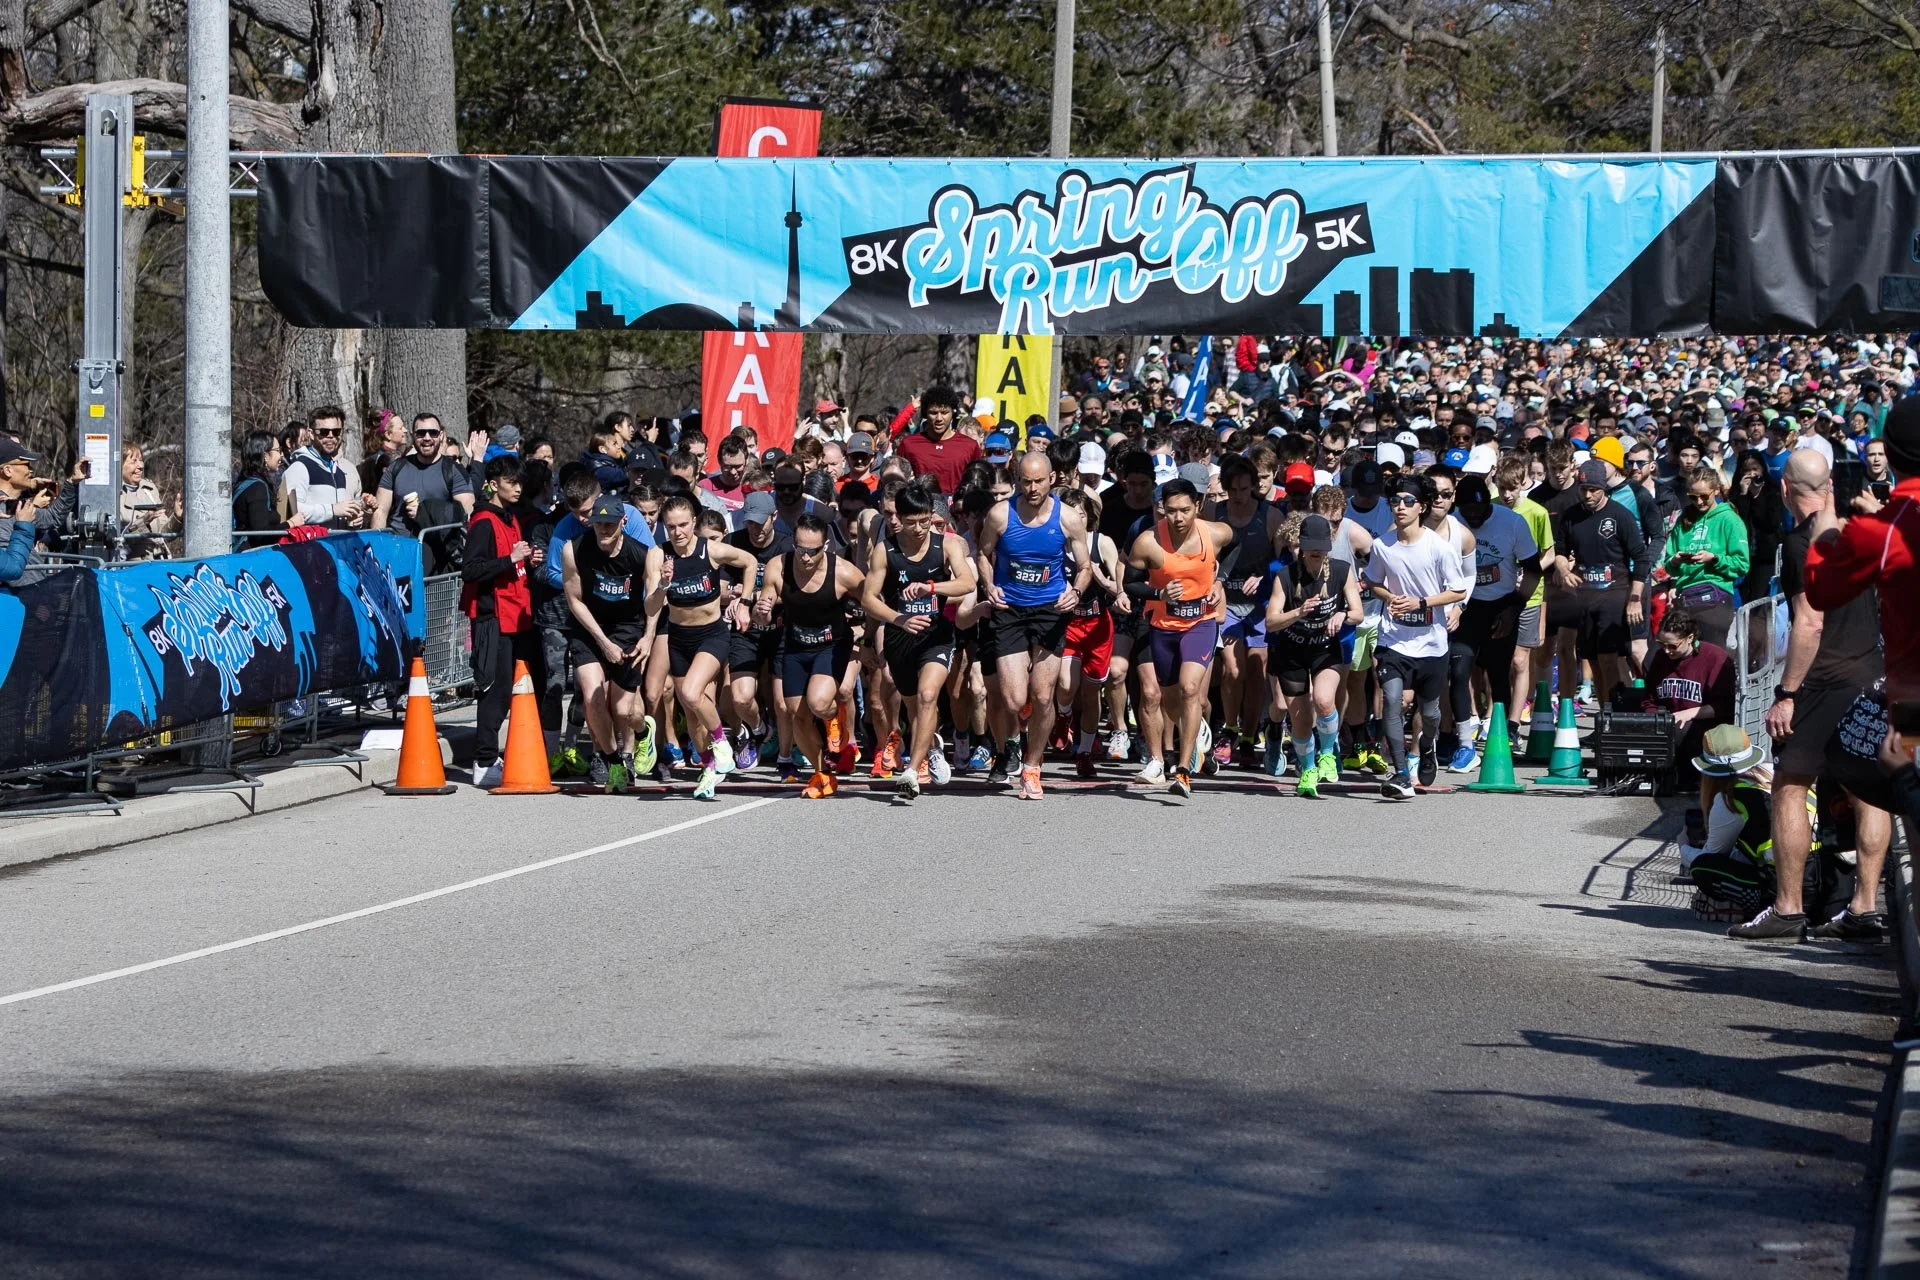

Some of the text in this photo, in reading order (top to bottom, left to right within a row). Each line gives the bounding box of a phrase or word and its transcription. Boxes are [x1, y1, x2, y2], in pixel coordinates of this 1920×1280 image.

[902, 169, 1202, 308] Spring
[1315, 214, 1368, 251] 5K
[850, 239, 899, 275] 8K
[1015, 570, 1042, 583] 3237
[1475, 574, 1493, 584] 683
[1583, 573, 1605, 582] 4045
[600, 582, 624, 595] 3488
[677, 583, 705, 595] 4204
[1226, 580, 1244, 590] 398
[266, 583, 287, 608] 5K
[398, 583, 410, 607] K
[905, 603, 932, 613] 3643
[1173, 607, 1200, 617] 3864
[149, 625, 174, 655] 8K
